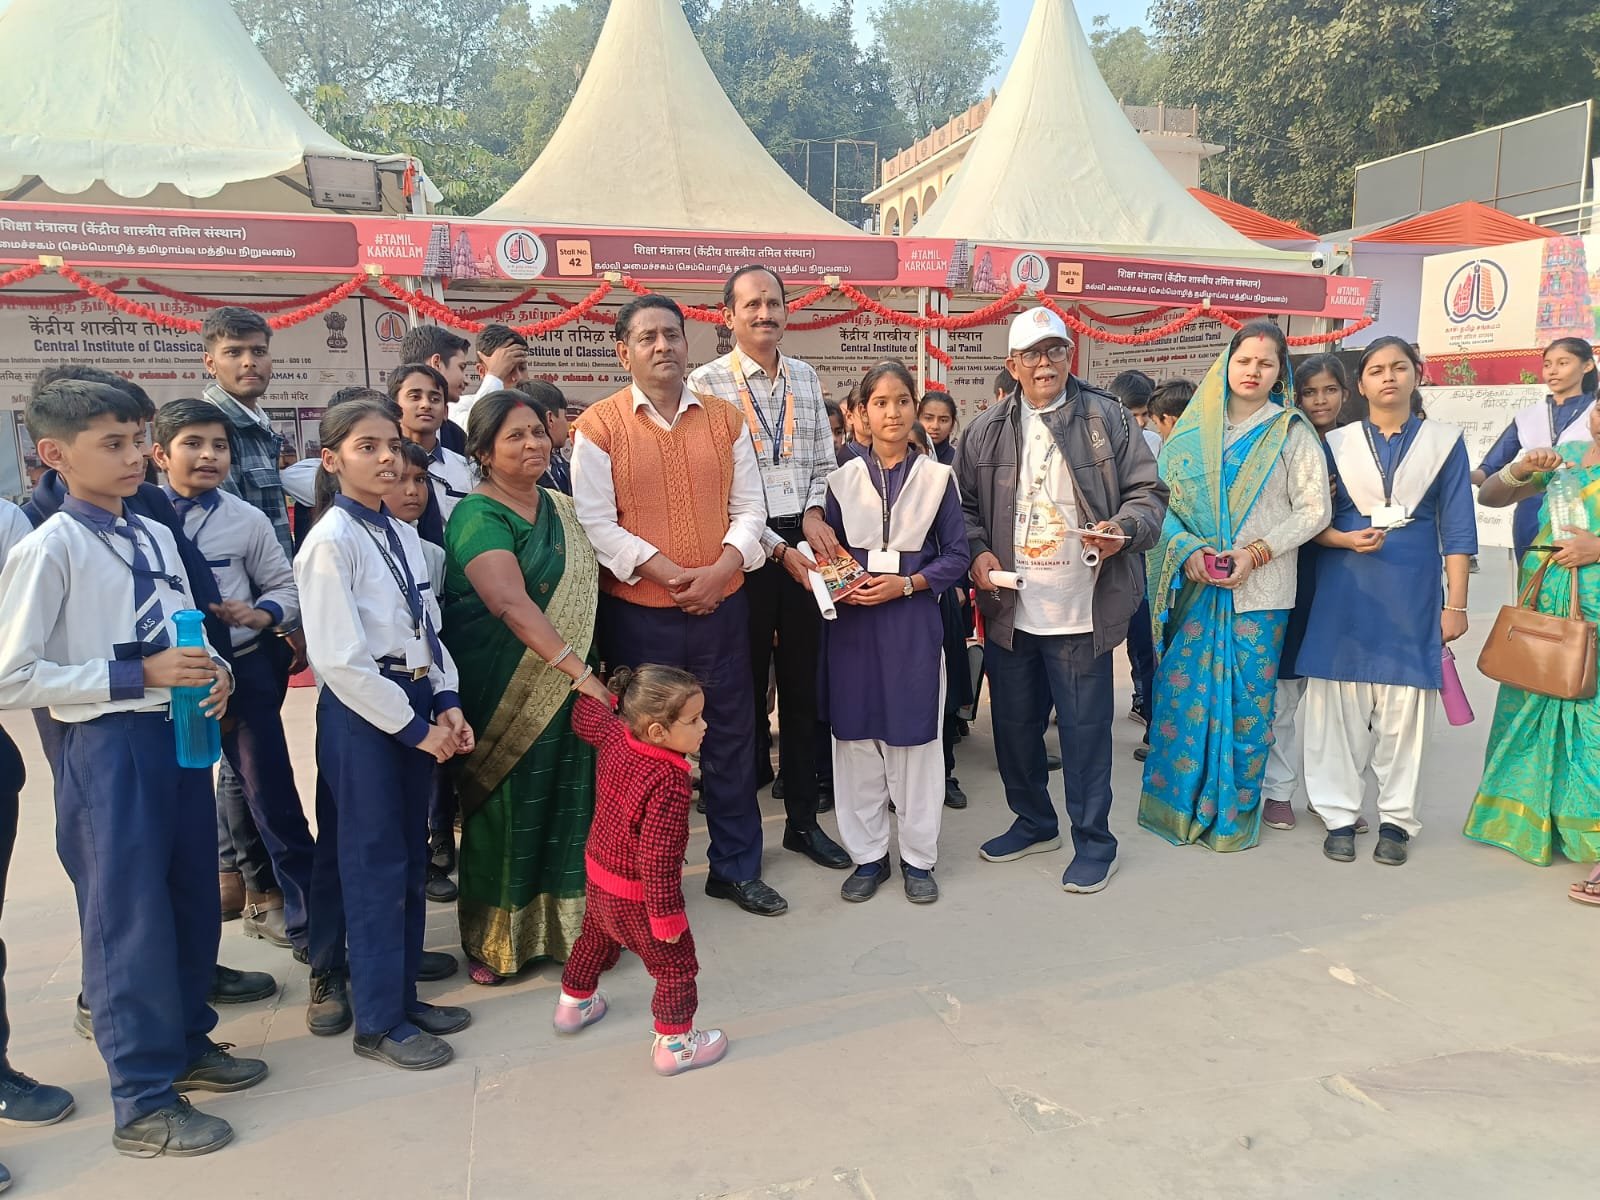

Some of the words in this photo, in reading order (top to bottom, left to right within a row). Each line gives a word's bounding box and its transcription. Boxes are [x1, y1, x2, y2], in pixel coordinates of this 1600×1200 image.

[1, 217, 32, 232] शिक्षा
[35, 219, 78, 234] मंत्रालय
[81, 221, 120, 236] (केंद्रीय
[123, 223, 166, 237] शास्त्रीय
[169, 224, 201, 238] तमिल
[203, 226, 247, 241] संस्थान)
[375, 233, 415, 246] #TAMIL
[198, 245, 237, 257] மத்திய
[367, 246, 423, 258] KARKALAM
[633, 243, 657, 255] शिक्षा
[659, 245, 691, 256] मंत्रालय
[693, 245, 721, 258] (केंद्रीय
[724, 246, 755, 258] शास्त्रीय
[757, 248, 782, 259] तमिल
[784, 249, 816, 259] संस्थान)
[911, 249, 941, 260] #TAMIL
[568, 258, 582, 267] 42
[904, 260, 947, 271] KARKALAM
[1117, 268, 1136, 279] शिक्षा
[1137, 269, 1163, 281] मंत्रालय
[1164, 271, 1187, 284] (केंद्रीय
[1188, 274, 1214, 286] शास्त्रीय
[1215, 275, 1235, 287] तमिल
[1236, 277, 1261, 289] संस्थान)
[1337, 286, 1361, 297] #TAMIL
[1331, 295, 1365, 306] KARKALAM
[28, 315, 75, 335] केंद्रीय
[80, 315, 138, 335] शास्त्रीय
[839, 327, 870, 341] केंद्रीय
[873, 328, 911, 341] शास्त्रीय
[34, 339, 80, 352] Central
[83, 340, 135, 352] Institute
[138, 340, 151, 352] of
[841, 343, 871, 352] Central
[873, 343, 907, 352] Institute
[959, 343, 982, 352] Tamil
[564, 346, 573, 358] of
[576, 347, 617, 358] Classica
